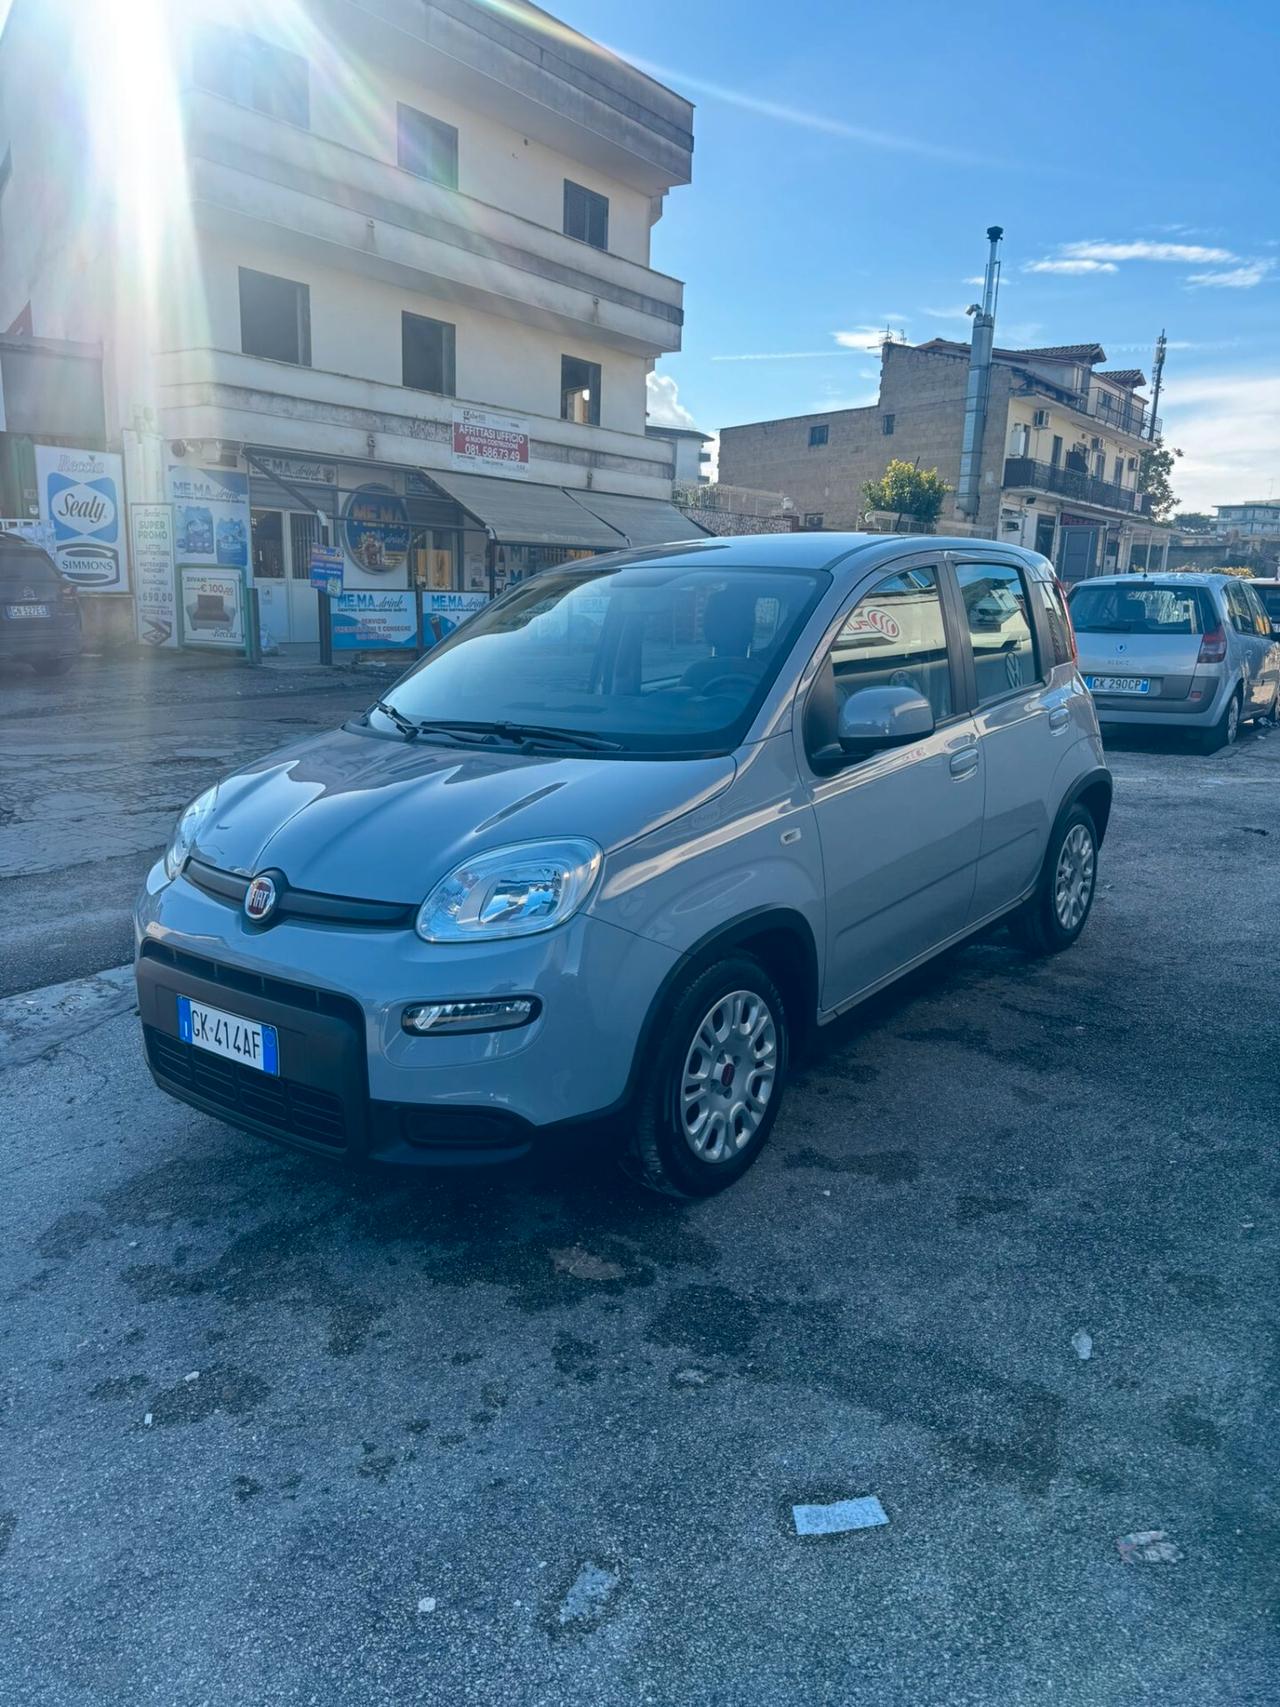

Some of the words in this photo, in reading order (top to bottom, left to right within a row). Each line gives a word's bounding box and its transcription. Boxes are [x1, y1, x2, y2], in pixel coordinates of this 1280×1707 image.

[459, 424, 496, 439] AFFITTASI
[58, 493, 105, 524] Sealy
[138, 520, 166, 530] SUPER
[137, 530, 168, 540] PROMO
[62, 560, 113, 571] SIMMONS
[1093, 678, 1107, 689] CK
[1109, 679, 1142, 690] 290CP
[250, 888, 270, 910] FIAT
[191, 1010, 210, 1042] GK
[213, 1018, 261, 1060] 414AF
